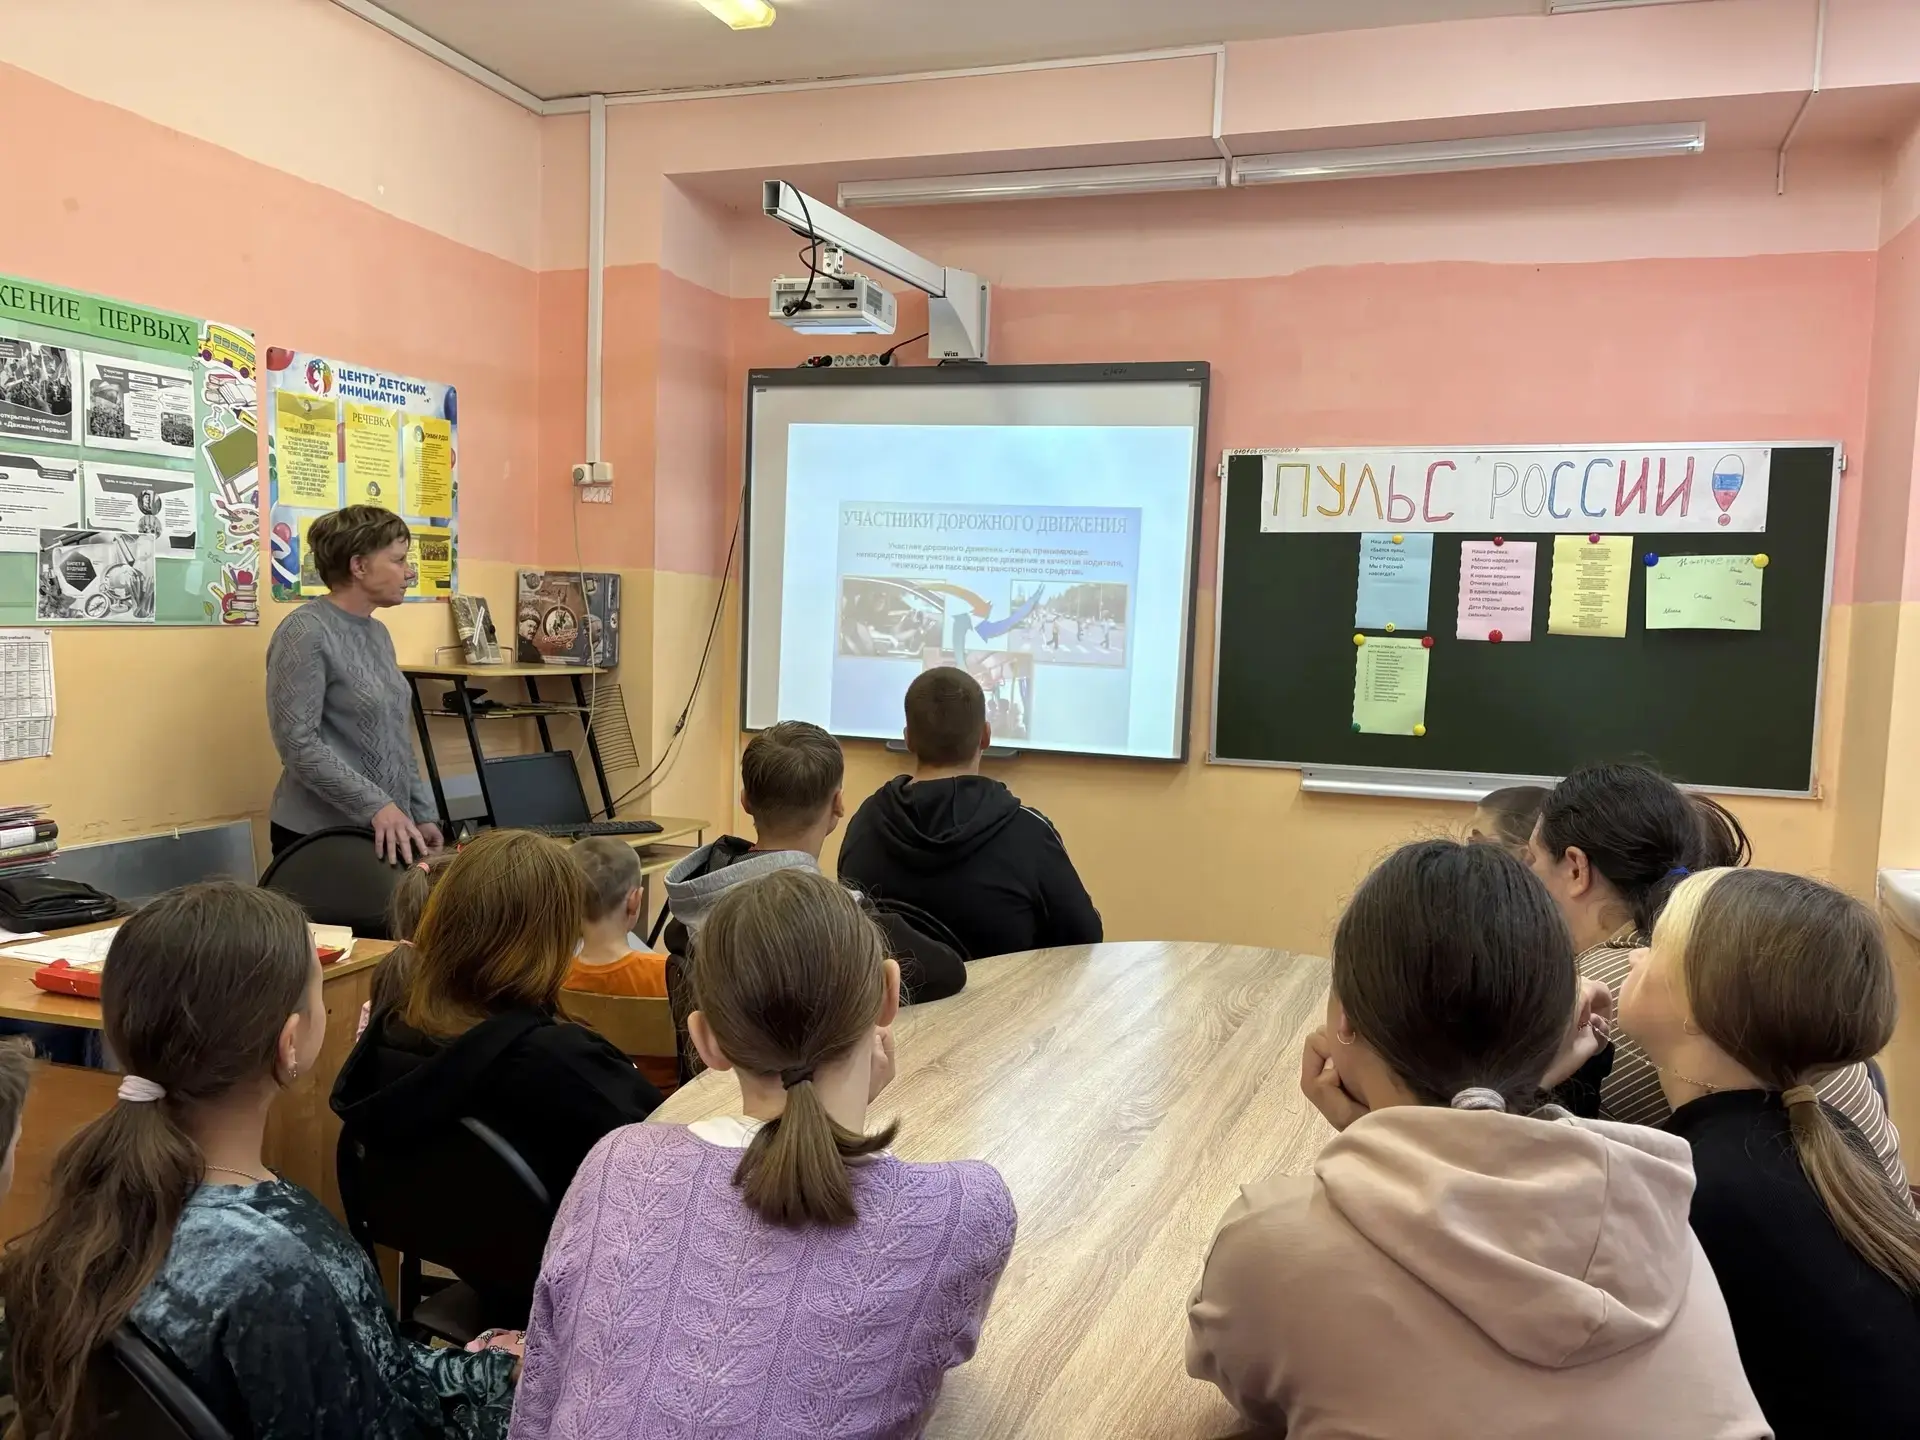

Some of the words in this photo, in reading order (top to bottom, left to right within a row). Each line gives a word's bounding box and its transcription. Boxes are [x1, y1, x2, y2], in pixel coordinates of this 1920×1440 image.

[98, 306, 191, 346] ПЕРВЫХ
[339, 368, 376, 386] ЦЕНТР
[379, 377, 426, 396] ДЕТСКИХ
[339, 384, 406, 406] ИНИЦИАТИВ
[352, 412, 392, 428] РЕЧЕВКА
[1273, 461, 1457, 523] ПУЛЬС
[843, 511, 934, 528] УЧАСТНИКИ
[936, 512, 1034, 533] ДОРОЖНОГО
[1036, 515, 1128, 537] ДВИЖЕНИЯ
